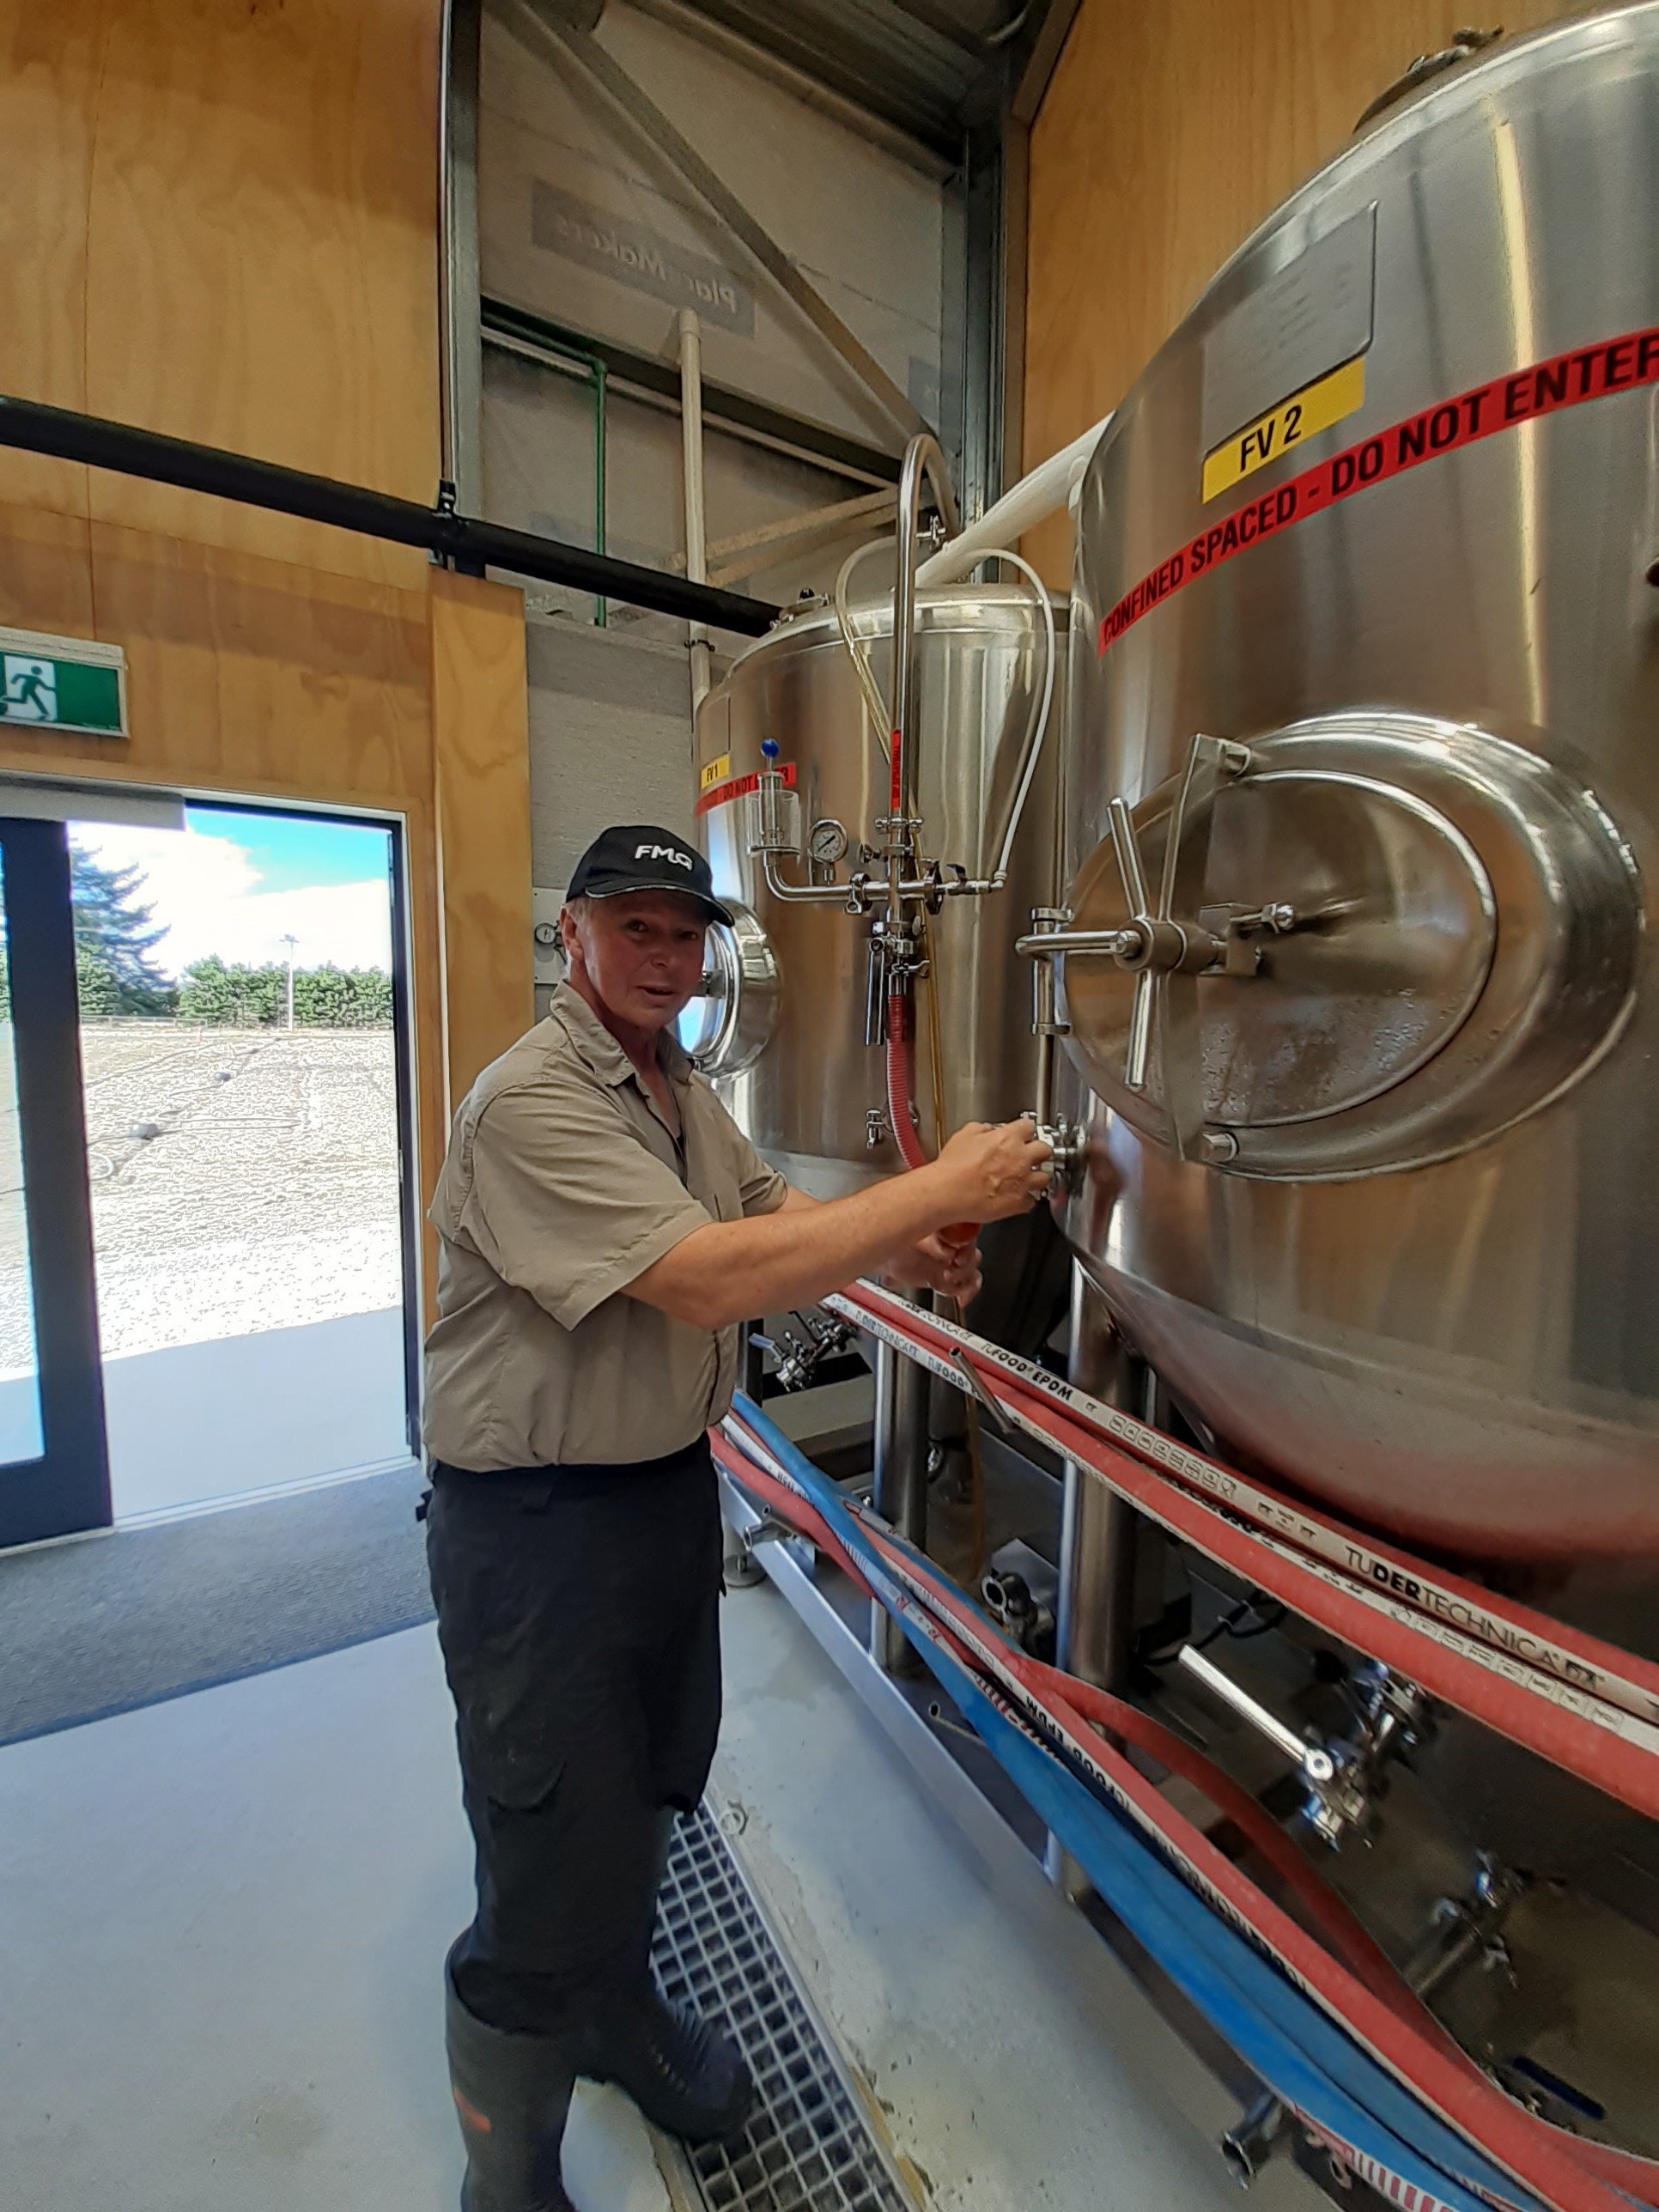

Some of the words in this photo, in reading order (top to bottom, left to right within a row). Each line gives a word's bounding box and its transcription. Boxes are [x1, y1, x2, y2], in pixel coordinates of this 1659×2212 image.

[1240, 419, 1276, 473] FV
[1282, 404, 1303, 447] 2
[1103, 552, 1185, 646] CONFINED
[1190, 484, 1297, 574] SPACED
[1331, 441, 1384, 497] DO
[1398, 389, 1491, 465] NOT
[735, 775, 753, 793] NOT
[1032, 1370, 1073, 1401] EPDM
